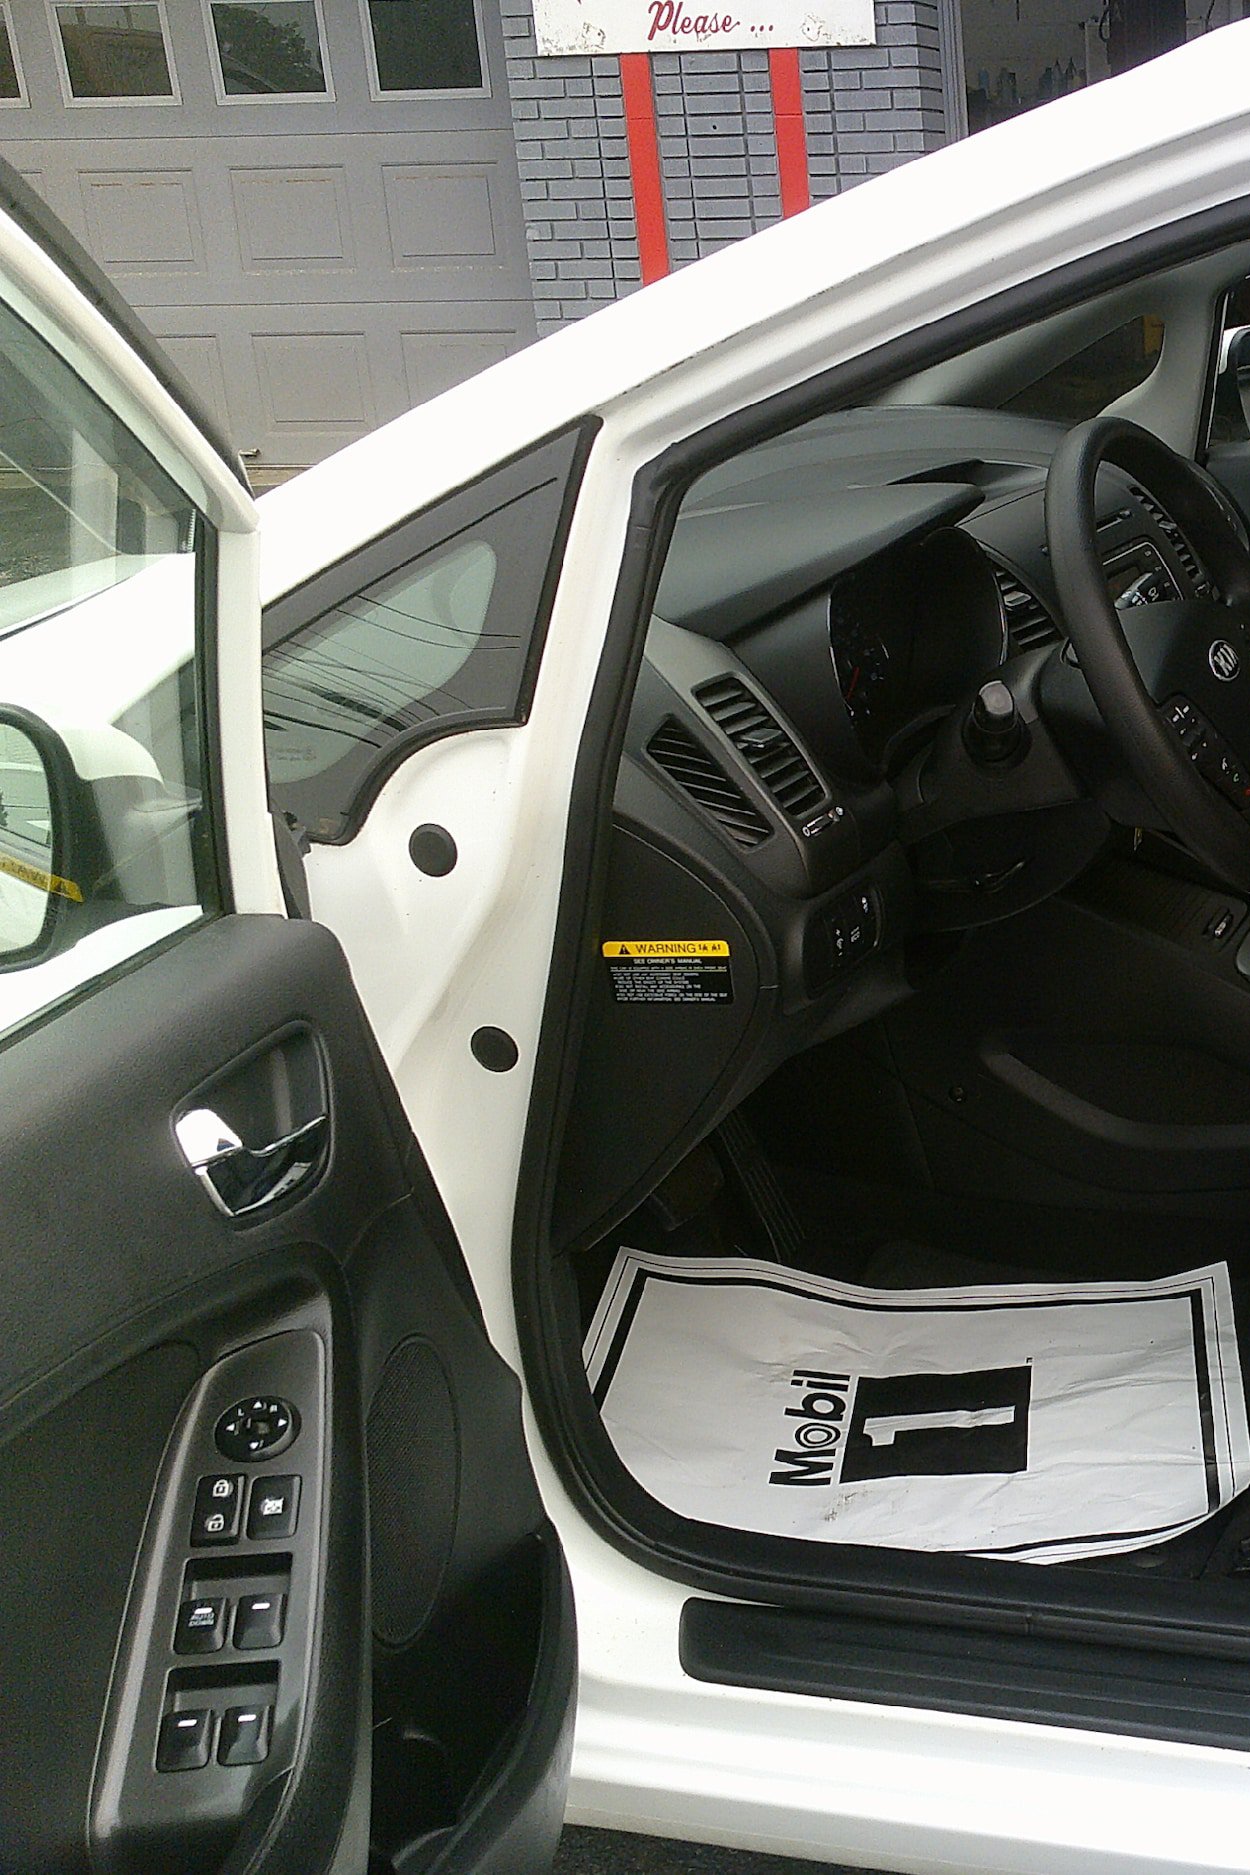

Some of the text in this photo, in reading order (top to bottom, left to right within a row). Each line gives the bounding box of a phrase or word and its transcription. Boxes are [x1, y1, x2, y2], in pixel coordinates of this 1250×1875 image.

[647, 0, 740, 41] Please
[635, 943, 696, 954] WARNING
[768, 1369, 850, 1486] Mobil
[863, 1405, 1016, 1447] 1
